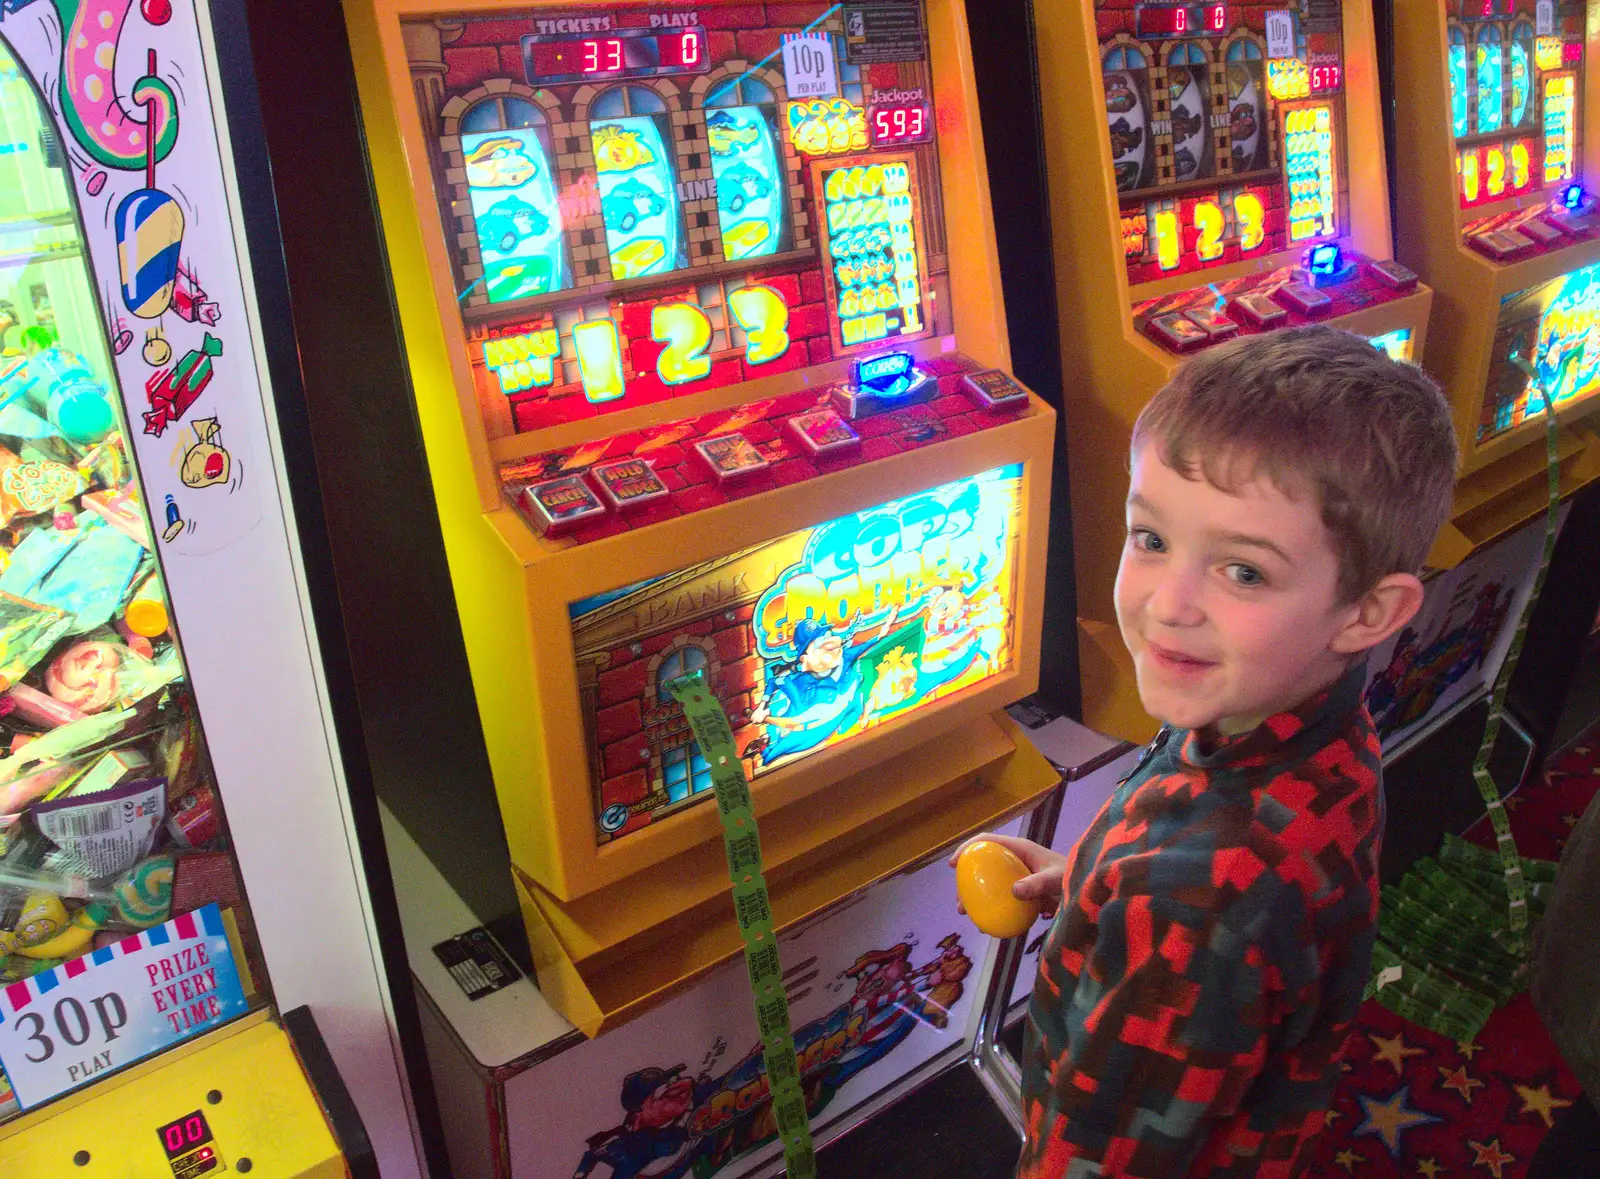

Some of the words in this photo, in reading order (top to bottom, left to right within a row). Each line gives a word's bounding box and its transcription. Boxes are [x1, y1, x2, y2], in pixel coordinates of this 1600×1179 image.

[536, 17, 611, 34] TICKETS
[650, 12, 698, 29] PLAYS
[1176, 9, 1185, 30] 0
[1215, 7, 1224, 29] 0
[1271, 18, 1288, 44] 10p
[584, 41, 620, 71] 33
[682, 33, 697, 64] 0
[792, 44, 825, 78] 10p
[797, 83, 811, 94] PER
[1313, 67, 1338, 88] 677
[870, 88, 923, 104] Jackpot
[876, 109, 922, 138] 593
[676, 179, 718, 202] LINE
[1194, 200, 1225, 261] 2
[1234, 193, 1264, 251] 3
[1155, 211, 1180, 270] 1
[728, 285, 789, 364] 3
[574, 317, 625, 402] 1
[652, 302, 711, 384] 2
[499, 356, 552, 392] NOW
[604, 464, 644, 481] HOLD
[541, 486, 588, 506] CANCEL
[811, 482, 981, 580] COPS
[649, 572, 752, 624] BANK
[145, 942, 211, 987] PRIZE
[151, 967, 219, 1013] EVERY
[14, 991, 128, 1063] 30p
[167, 995, 221, 1033] TIME
[67, 1050, 114, 1082] PLAY
[165, 1116, 203, 1151] 00
